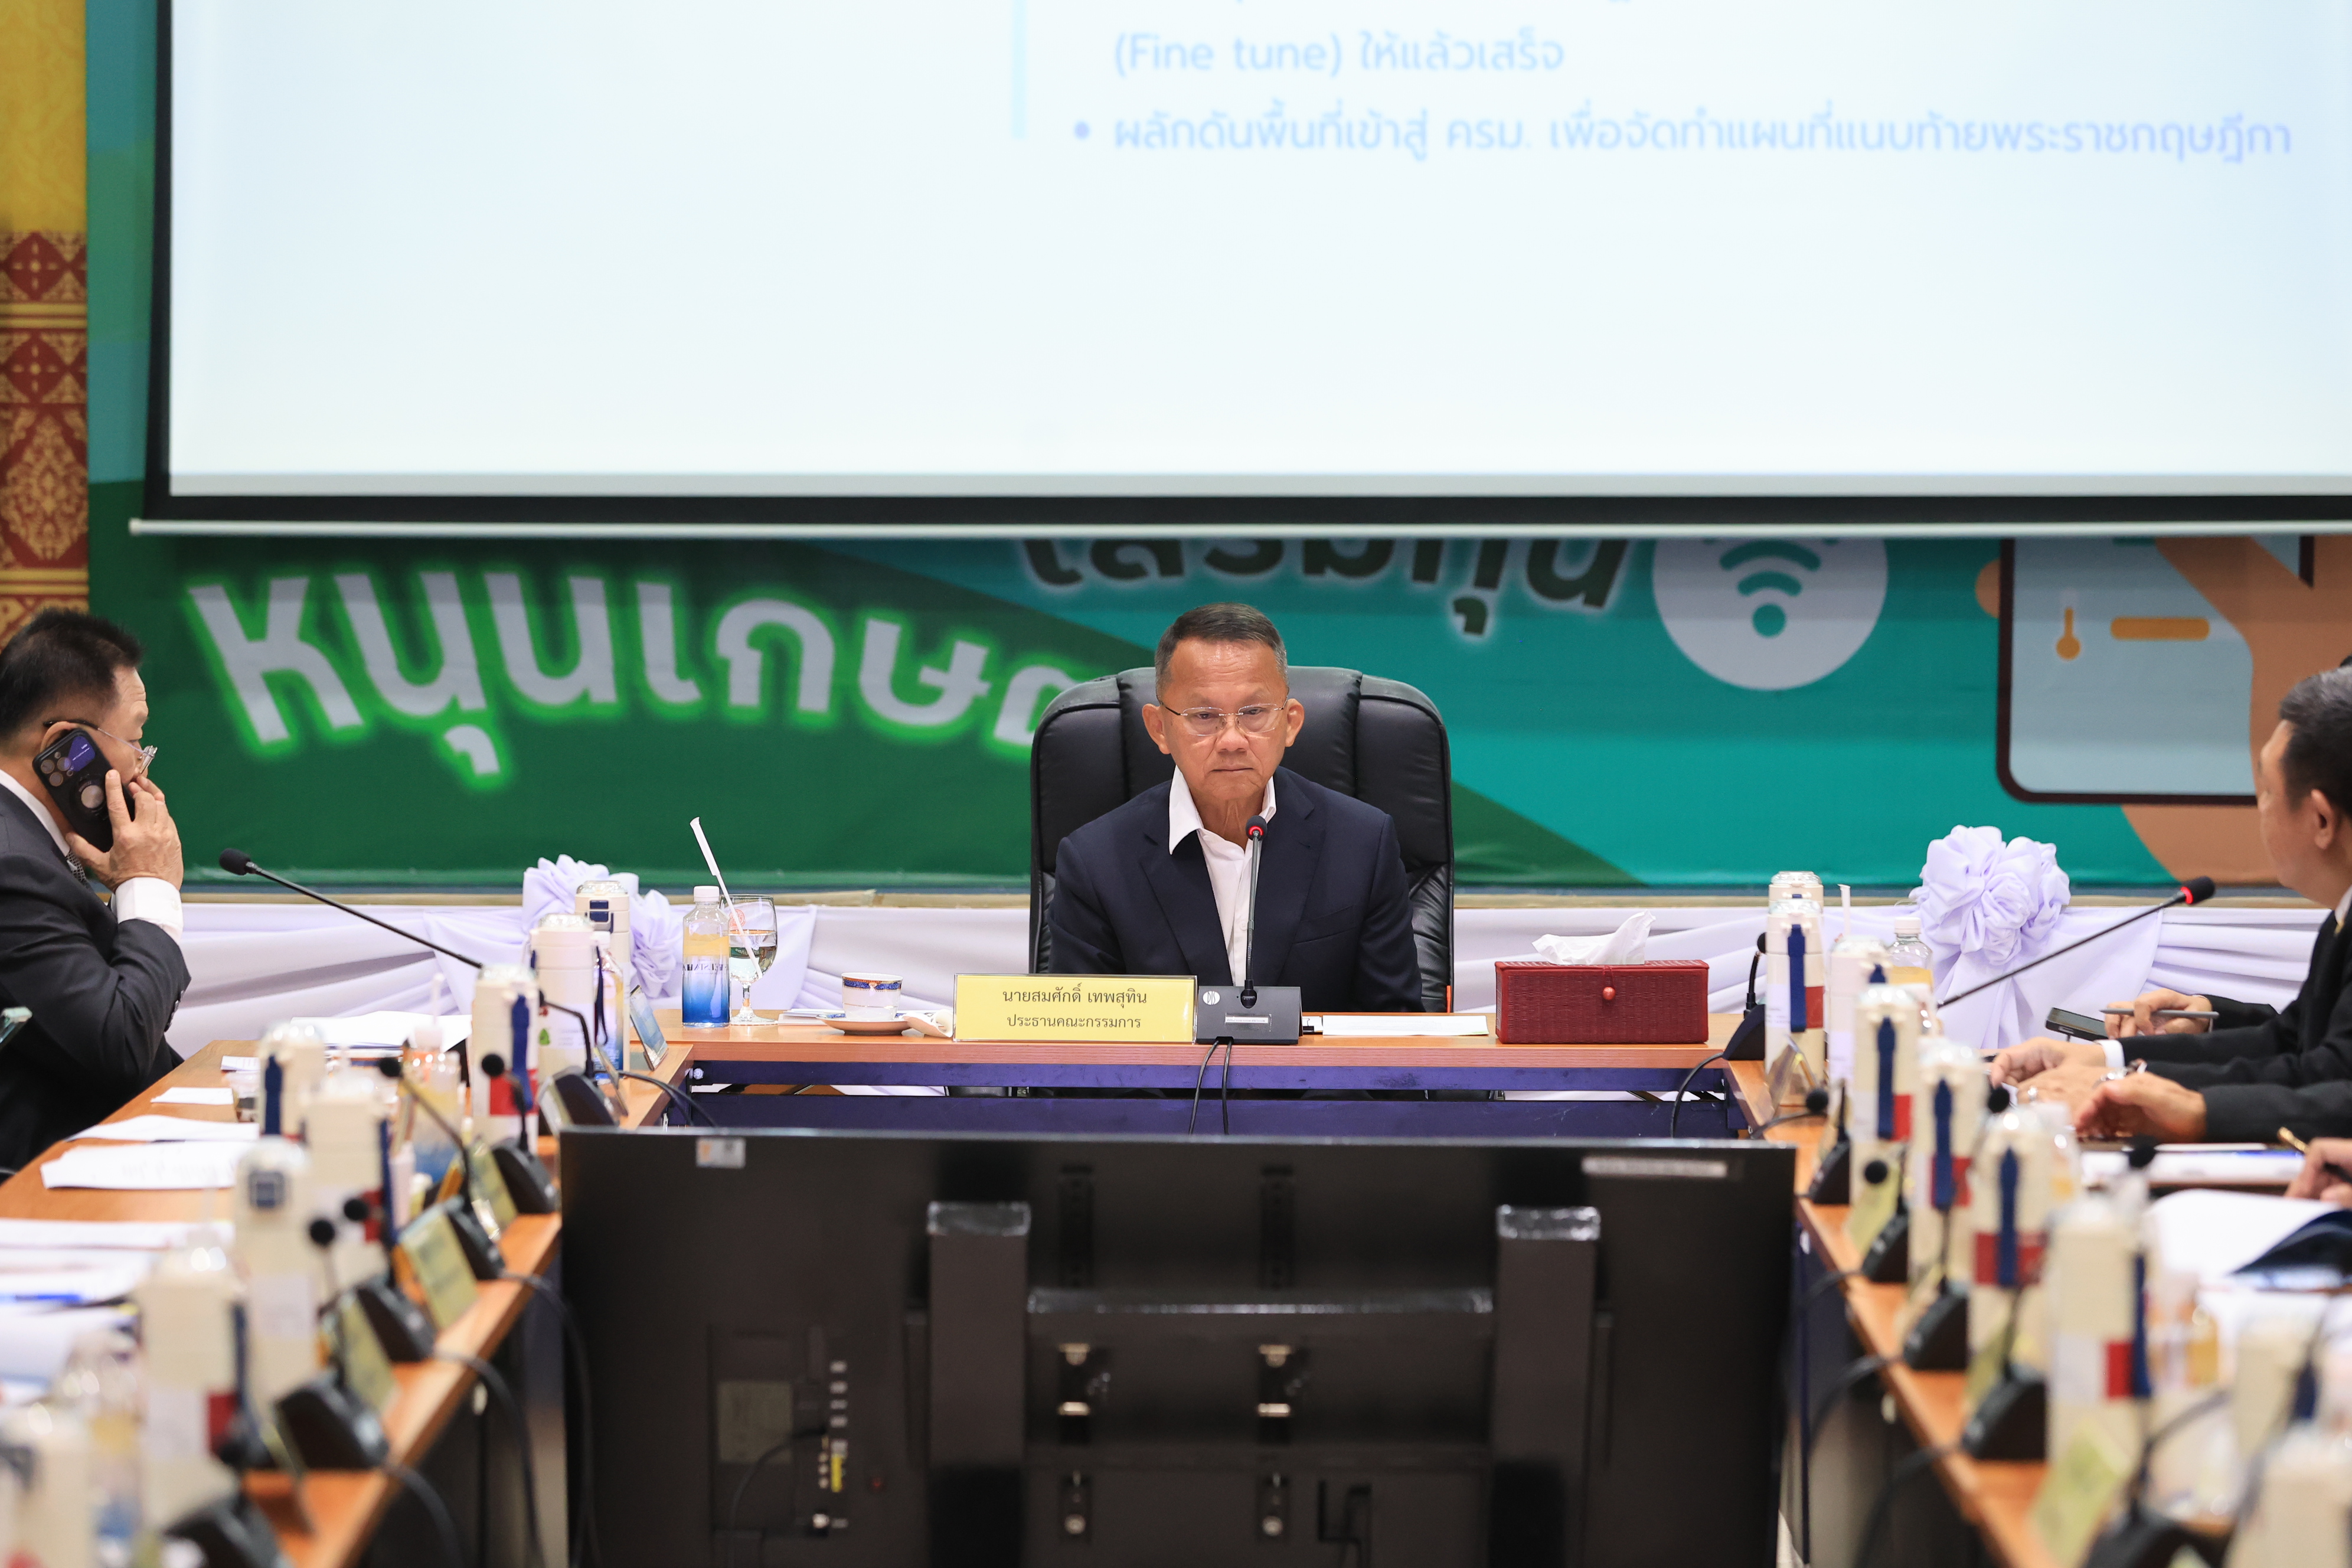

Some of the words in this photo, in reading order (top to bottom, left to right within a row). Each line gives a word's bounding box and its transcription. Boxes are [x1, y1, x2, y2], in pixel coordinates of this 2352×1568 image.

[1113, 31, 1215, 79] (Fine
[1232, 31, 1344, 79] tune)
[1358, 24, 1566, 72] ให้แล้วเสร็จ
[1113, 97, 1429, 164] ผลักดันพื้นที่เข้าสู่
[1446, 117, 1533, 151] ครม.
[1002, 982, 1082, 1002] นายสมศักดิ์
[1087, 988, 1147, 1009] เทพสุทิน
[1007, 1014, 1141, 1028] ประธานคณะกรรมการ
